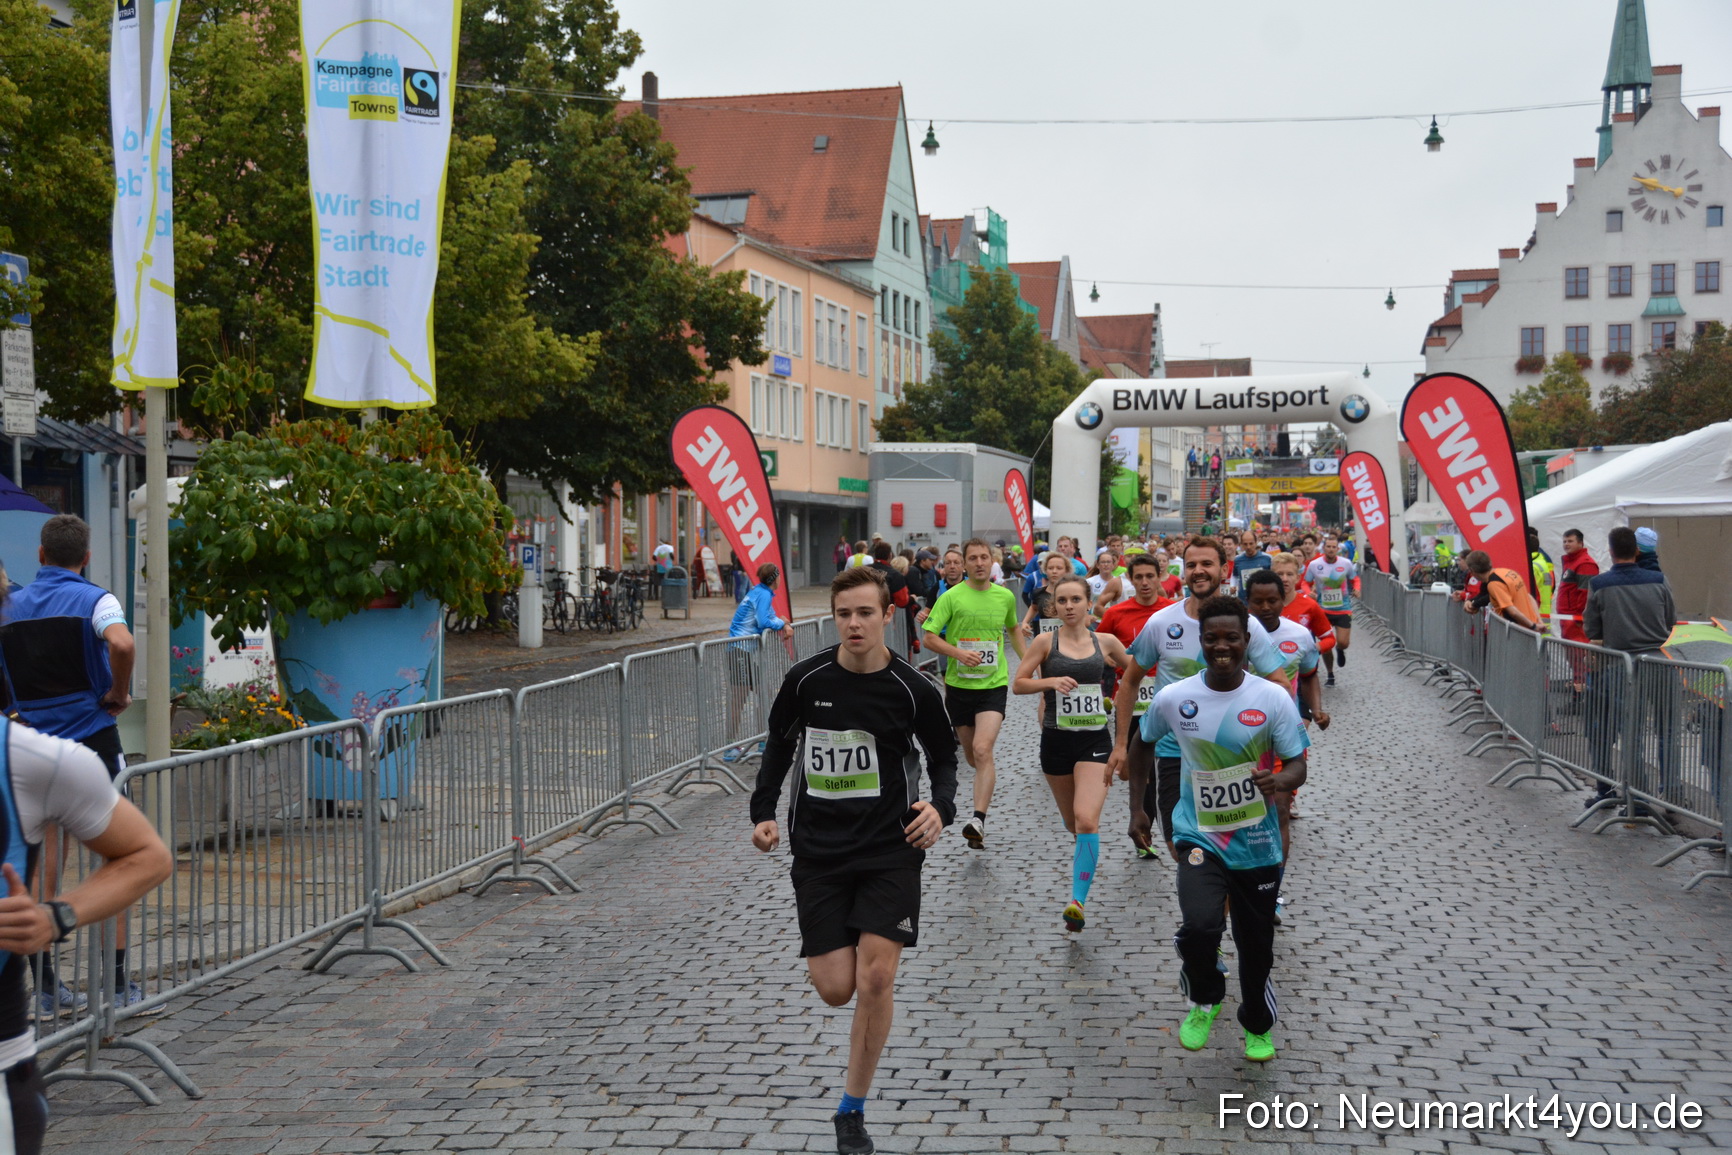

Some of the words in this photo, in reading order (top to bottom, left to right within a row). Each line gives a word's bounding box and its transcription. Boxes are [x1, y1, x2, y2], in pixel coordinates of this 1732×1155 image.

[317, 61, 393, 78] Kampagne
[317, 75, 400, 95] Fairtrade
[350, 100, 396, 114] Towns
[405, 106, 438, 116] FAIRTRADE
[315, 192, 360, 216] Wir
[369, 194, 420, 221] sind
[324, 264, 389, 287] Stadt
[1113, 388, 1187, 410] BMW
[1195, 385, 1329, 412] Laufsport
[1271, 480, 1297, 490] ZIEL
[524, 549, 533, 561] P
[1062, 696, 1100, 714] 5181
[1241, 713, 1264, 722] Hervis
[811, 745, 871, 772] 5170
[825, 779, 856, 790] Stefan
[1200, 778, 1256, 809] 5209
[1215, 810, 1247, 823] Mutala
